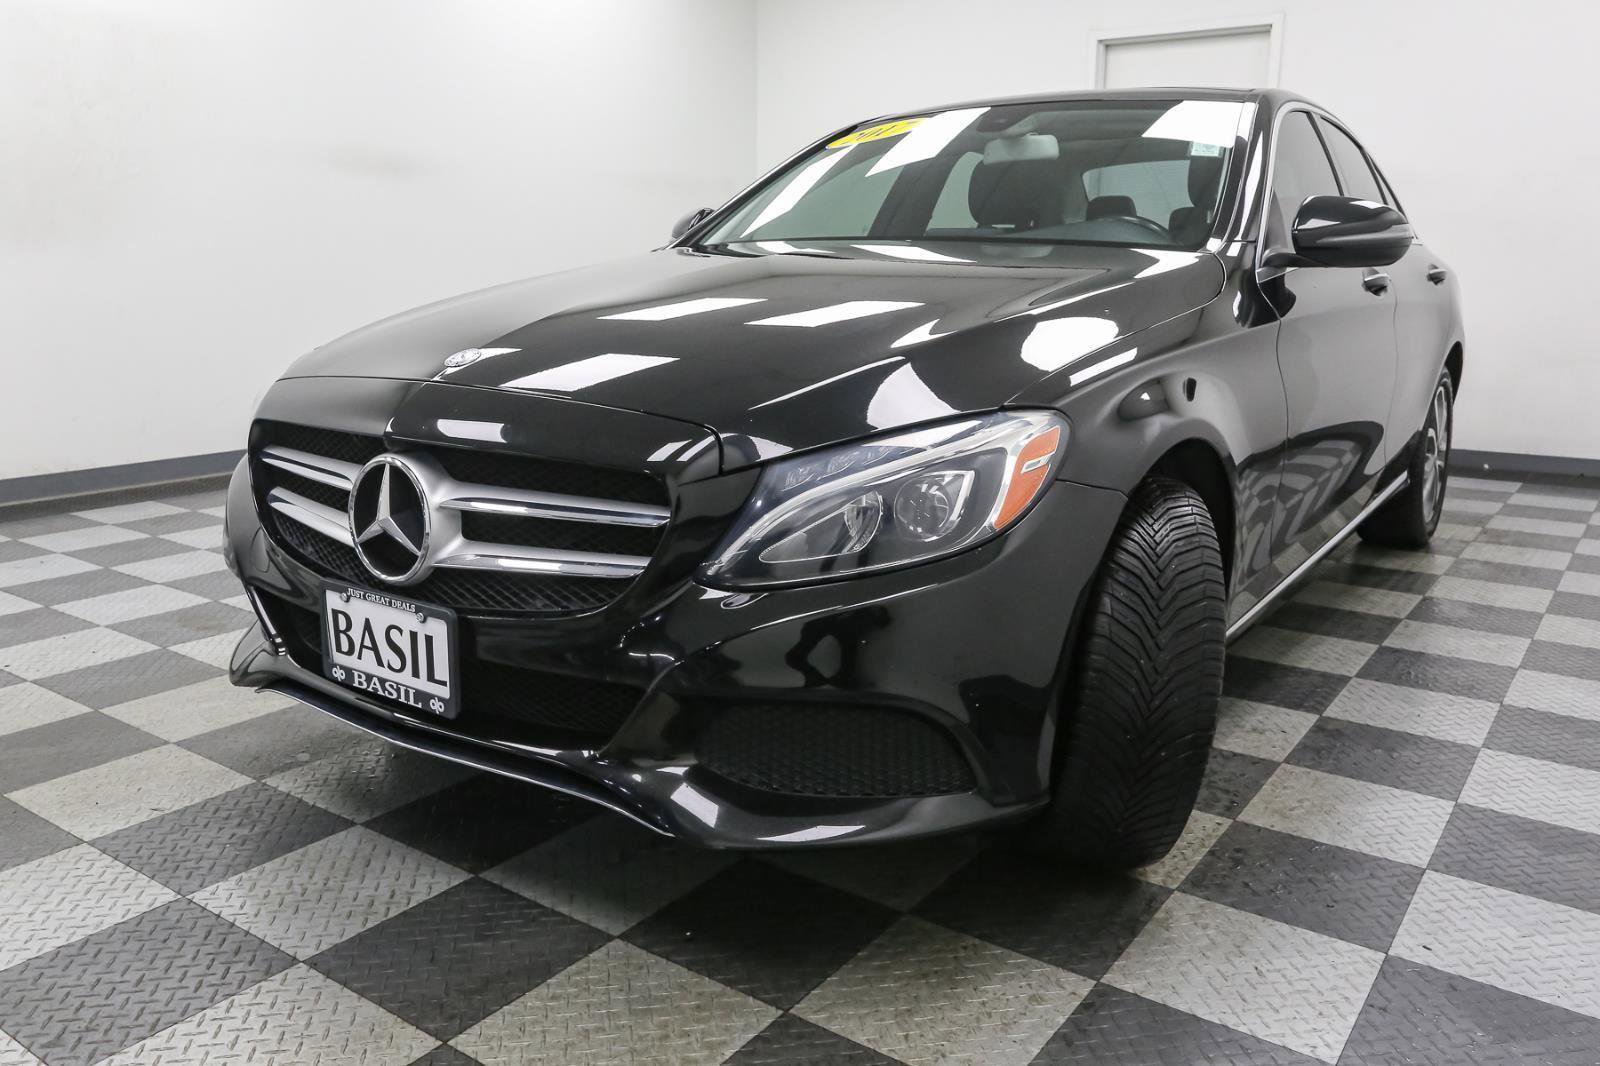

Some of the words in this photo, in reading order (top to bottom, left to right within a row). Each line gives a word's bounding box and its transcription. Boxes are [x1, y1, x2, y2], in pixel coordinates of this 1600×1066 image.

[347, 588, 365, 600] JUST
[366, 593, 390, 606] GREAT
[391, 599, 416, 613] DEALS
[331, 608, 448, 688] BASIL
[351, 670, 422, 708] BASIL
